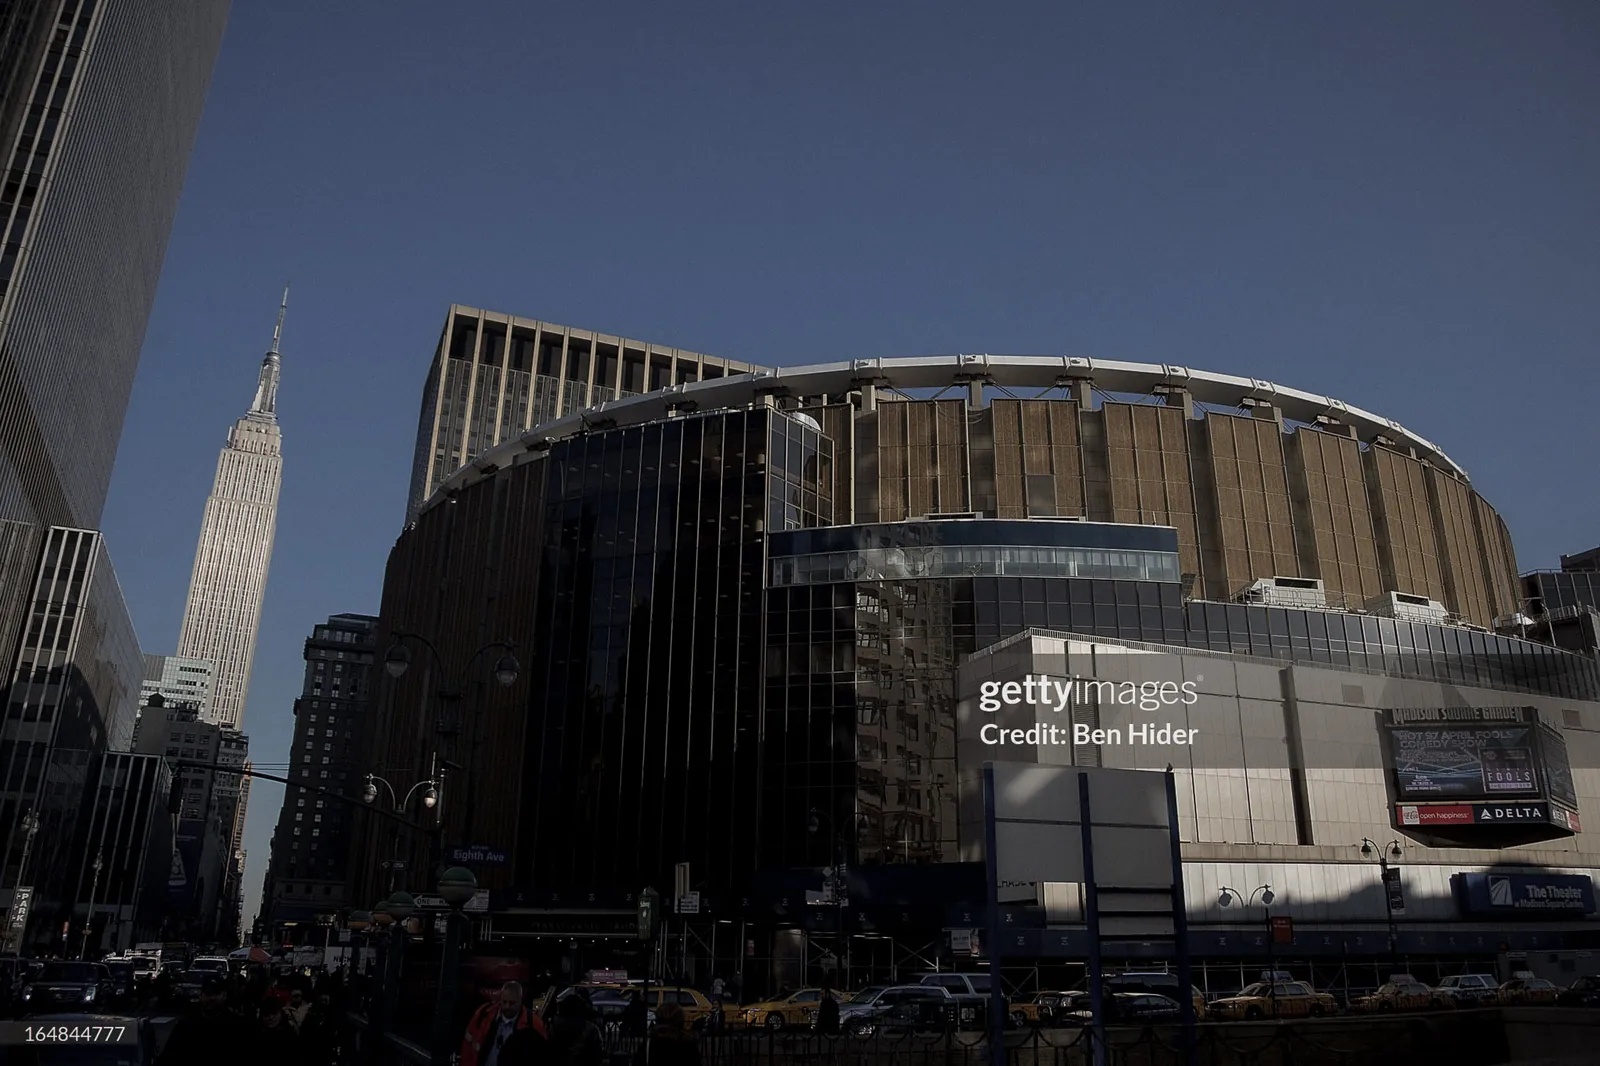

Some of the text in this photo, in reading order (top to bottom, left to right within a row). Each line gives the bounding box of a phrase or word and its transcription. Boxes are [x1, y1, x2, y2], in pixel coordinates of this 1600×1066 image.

[1441, 731, 1475, 740] APRIL
[1476, 730, 1514, 739] FOOLS
[1400, 739, 1487, 748] COMEDY SHOW
[1487, 771, 1531, 782] FOOLS
[1419, 812, 1436, 820] open
[1437, 810, 1468, 820] happiness
[1495, 808, 1542, 818] DELTA
[453, 848, 505, 862] Eighth Ave
[1525, 884, 1583, 899] The Theater
[16, 893, 30, 922] PARK
